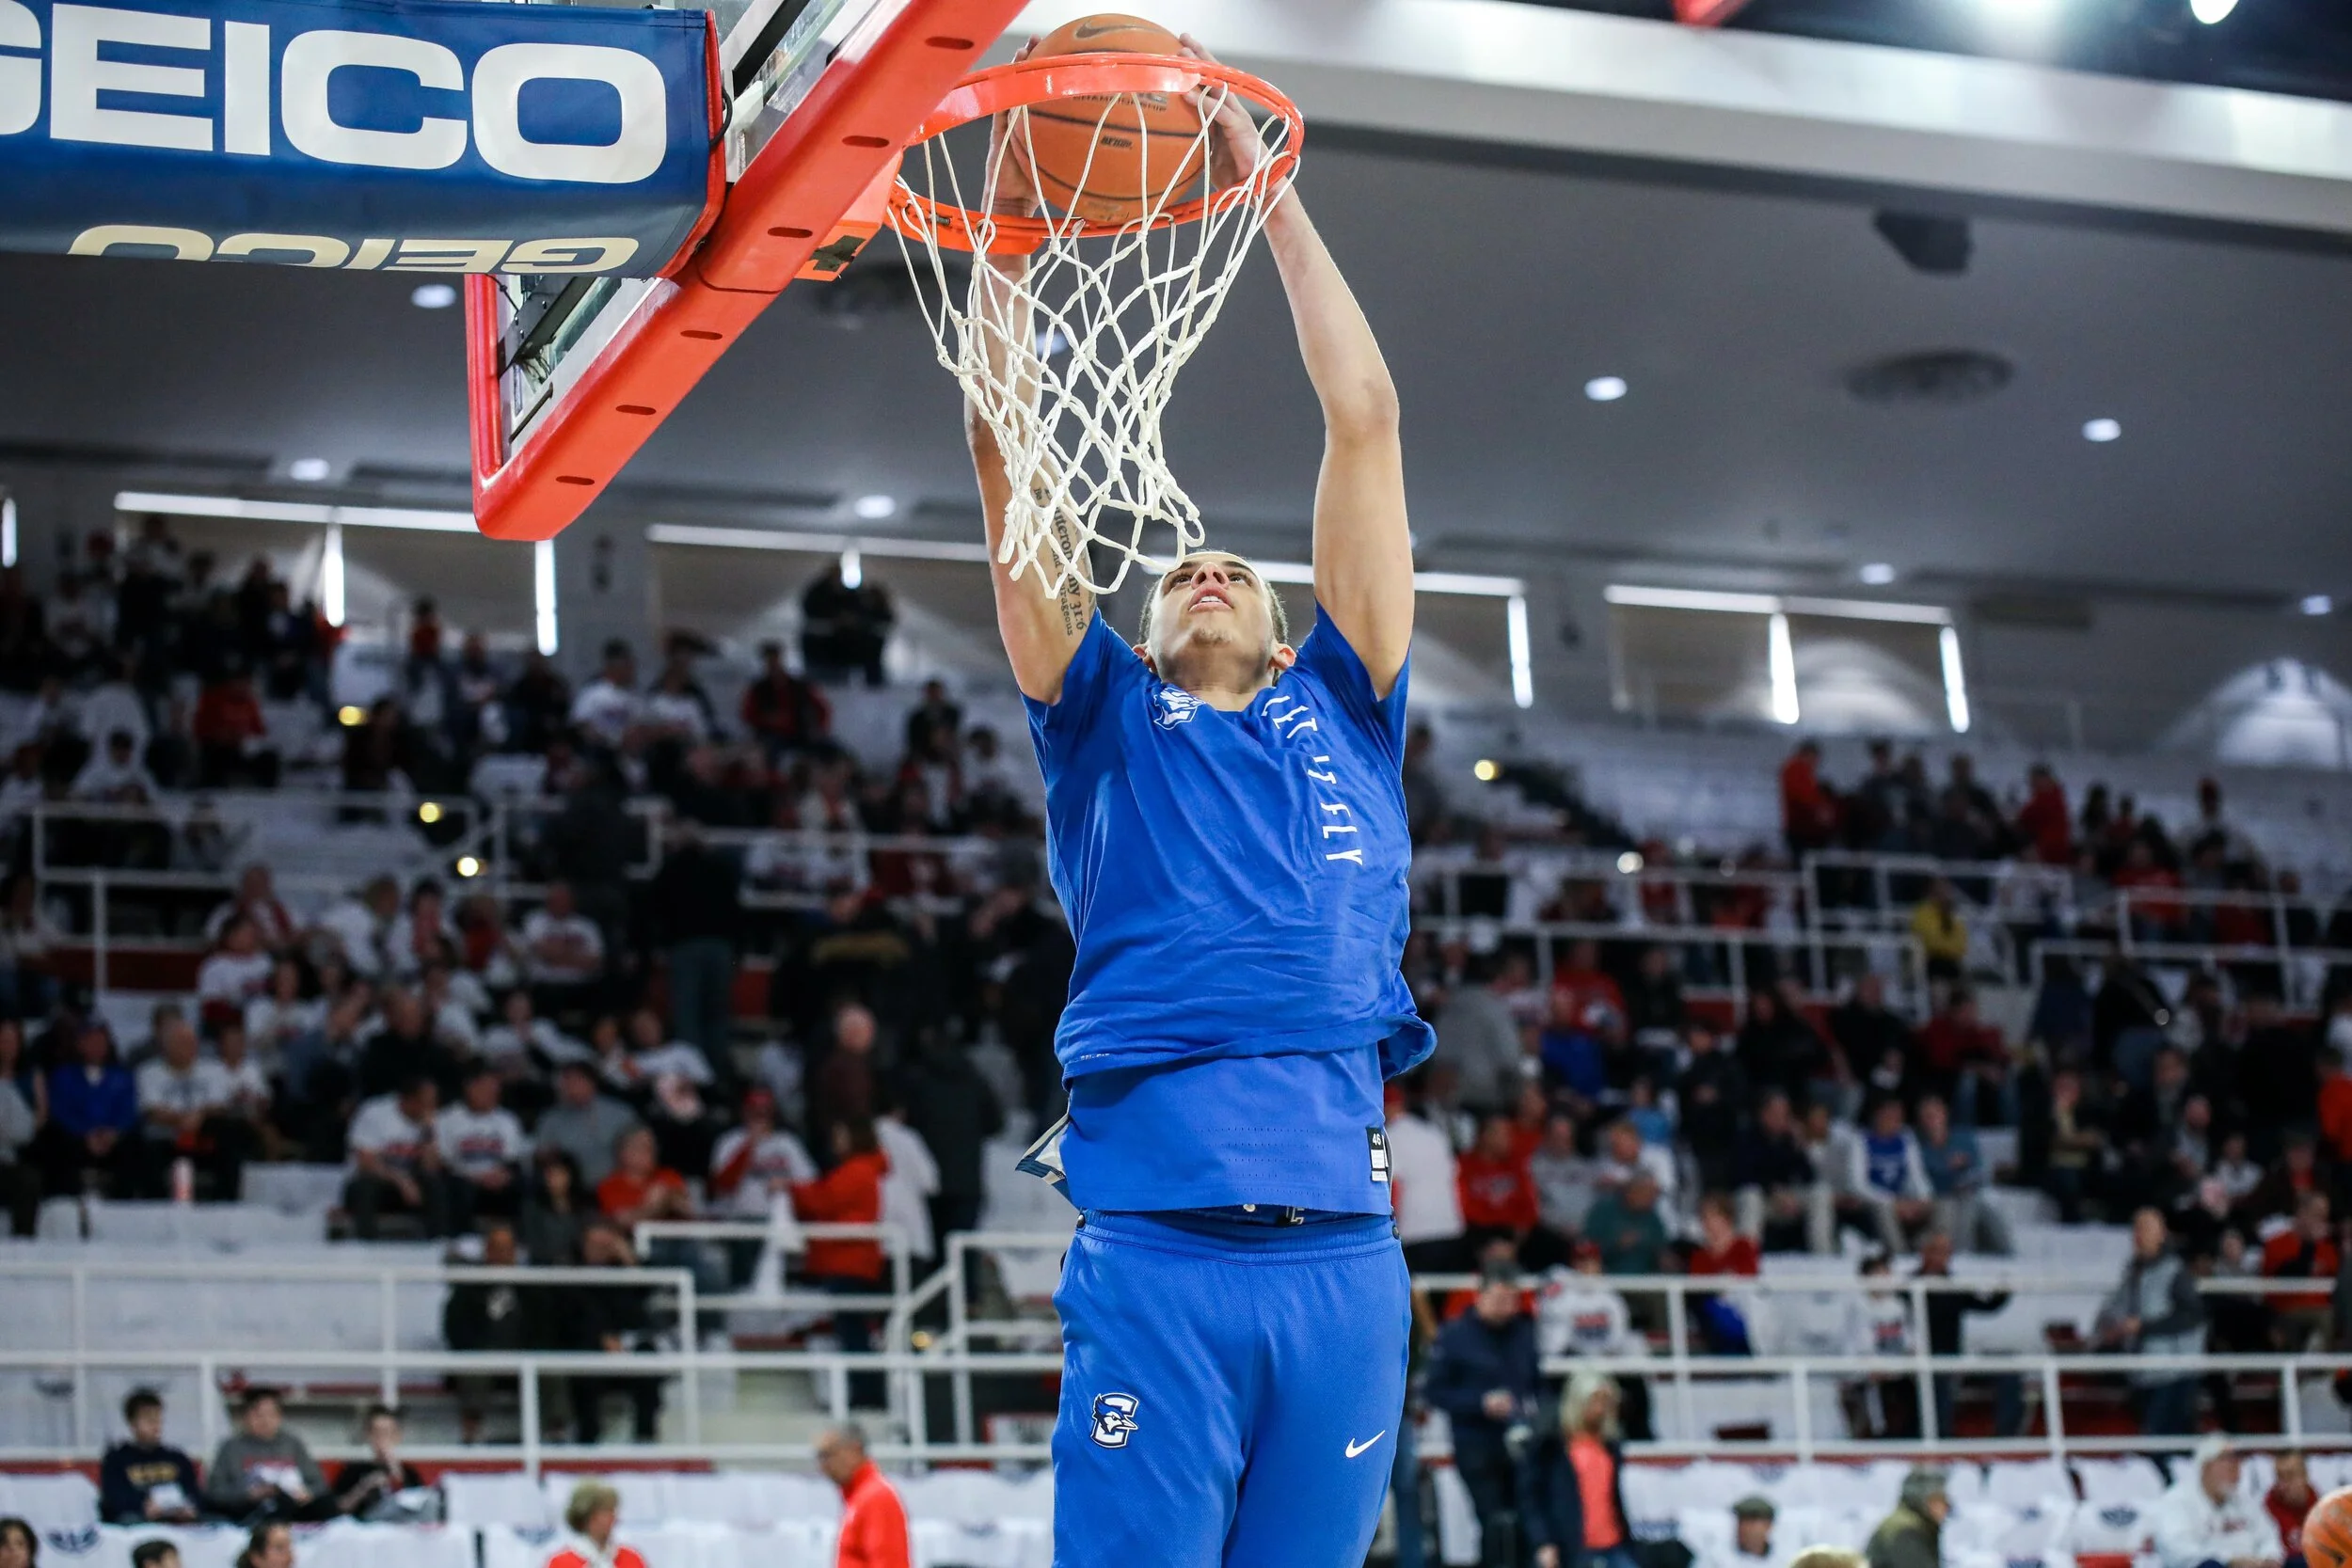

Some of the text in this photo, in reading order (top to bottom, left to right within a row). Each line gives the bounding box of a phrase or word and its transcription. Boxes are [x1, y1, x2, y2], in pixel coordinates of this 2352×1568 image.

[0, 0, 666, 183] EICO
[1070, 601, 1087, 630] 31:6
[1261, 696, 1363, 865] LET IT FLY
[1372, 1132, 1381, 1146] 46
